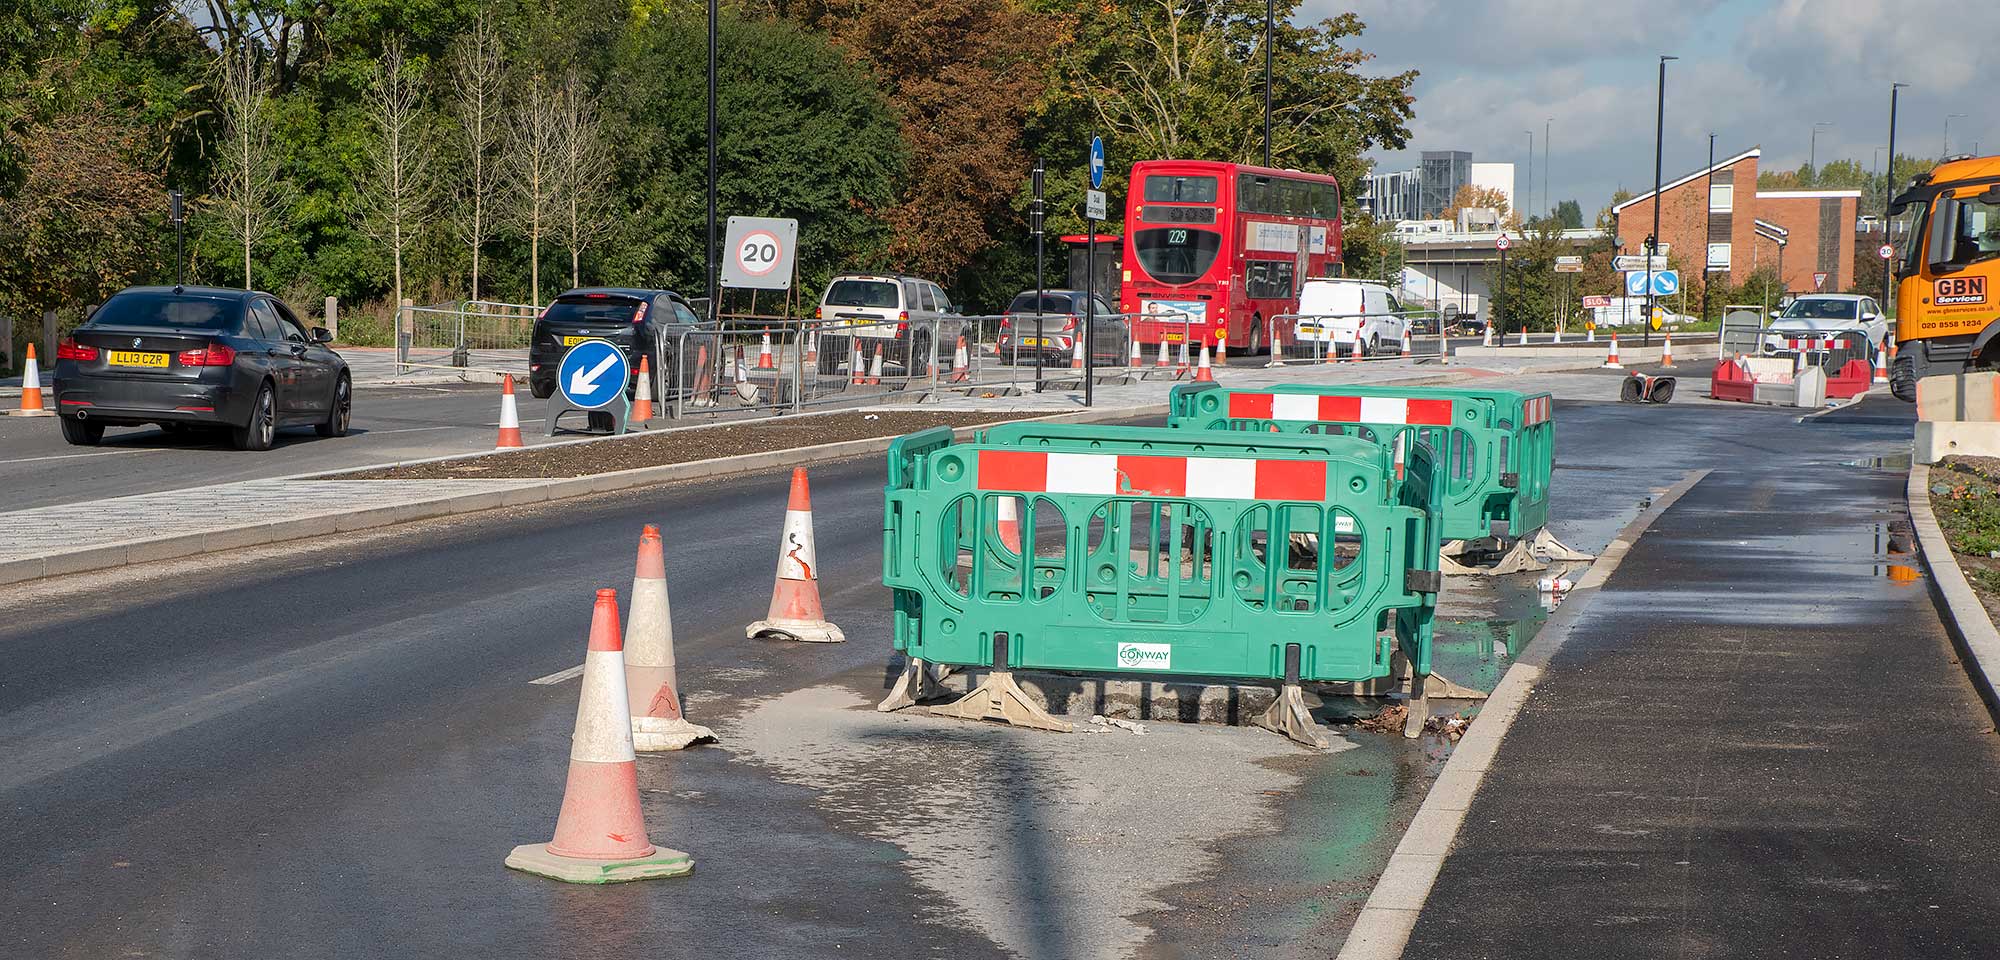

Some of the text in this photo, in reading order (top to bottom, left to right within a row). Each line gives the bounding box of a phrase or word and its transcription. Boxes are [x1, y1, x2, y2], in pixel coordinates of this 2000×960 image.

[1169, 230, 1187, 243] 229
[743, 243, 776, 262] 20
[1938, 279, 1982, 295] GBN
[1586, 298, 1609, 306] SLOW
[1937, 295, 1983, 303] Services
[117, 353, 163, 364] LL13 CZR
[1119, 650, 1169, 660] CONWAY
